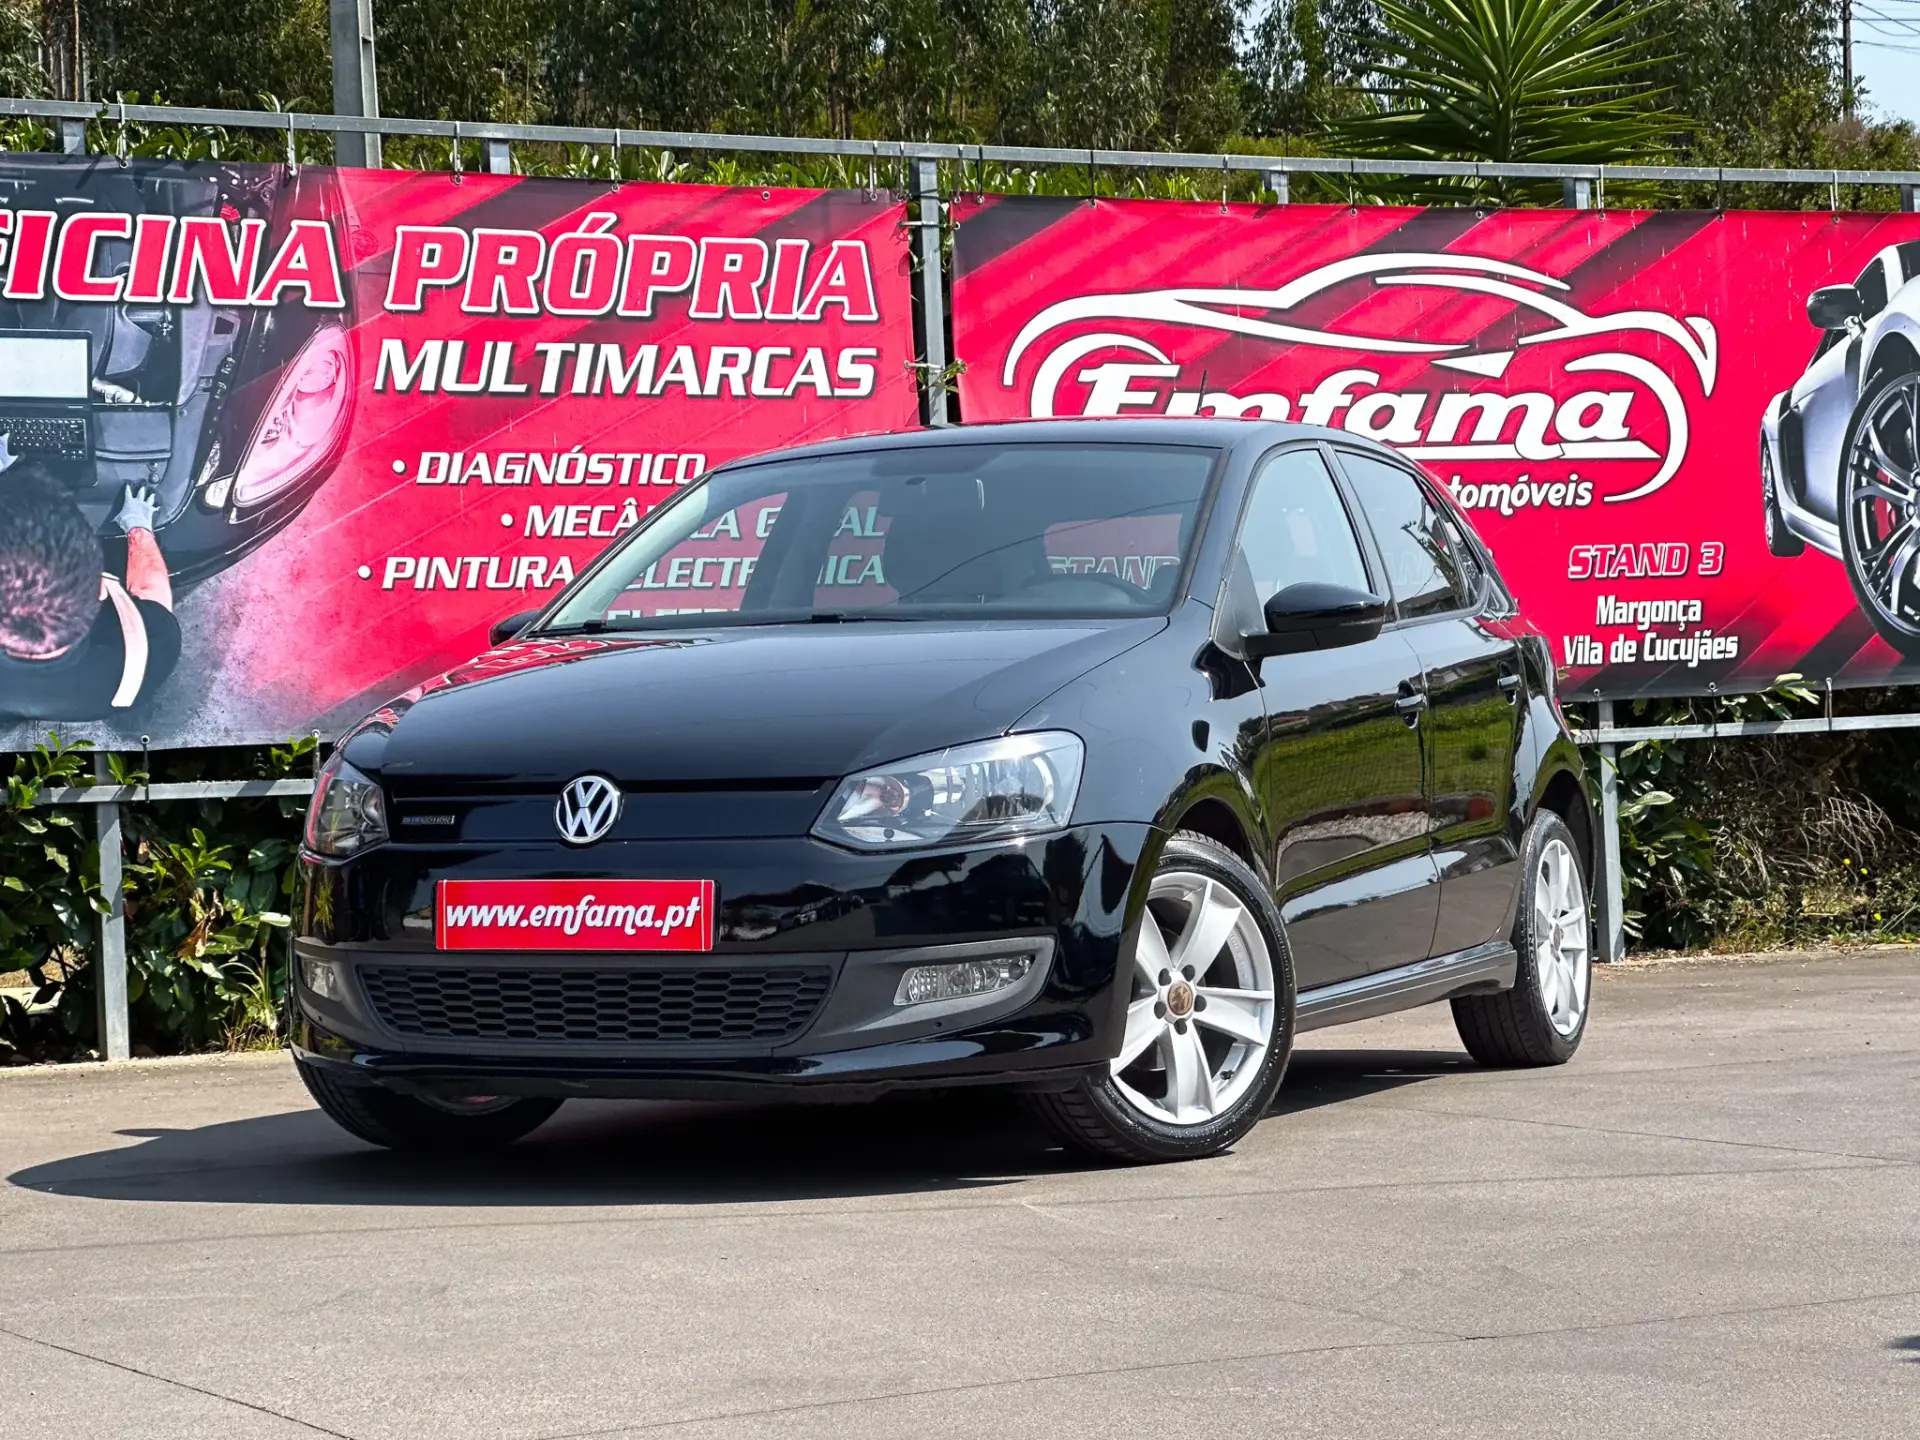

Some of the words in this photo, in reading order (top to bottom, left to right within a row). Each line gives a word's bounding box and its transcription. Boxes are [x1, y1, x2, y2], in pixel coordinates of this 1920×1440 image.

[384, 212, 878, 321] PRÓPRIA
[374, 338, 877, 397] MULTIMARCAS
[416, 446, 705, 485] DIAGNÓSTICO
[1447, 474, 1593, 516] tomóveis
[524, 497, 740, 538] MECÂA
[382, 556, 574, 589] PINTURA
[1568, 543, 1689, 579] STAND
[1698, 541, 1724, 575] 3
[1596, 595, 1702, 631] Margonça
[1563, 635, 1603, 665] Vila
[1610, 633, 1636, 663] de
[1643, 630, 1739, 668] Cucujães
[446, 894, 701, 937] www.emfama.pt
